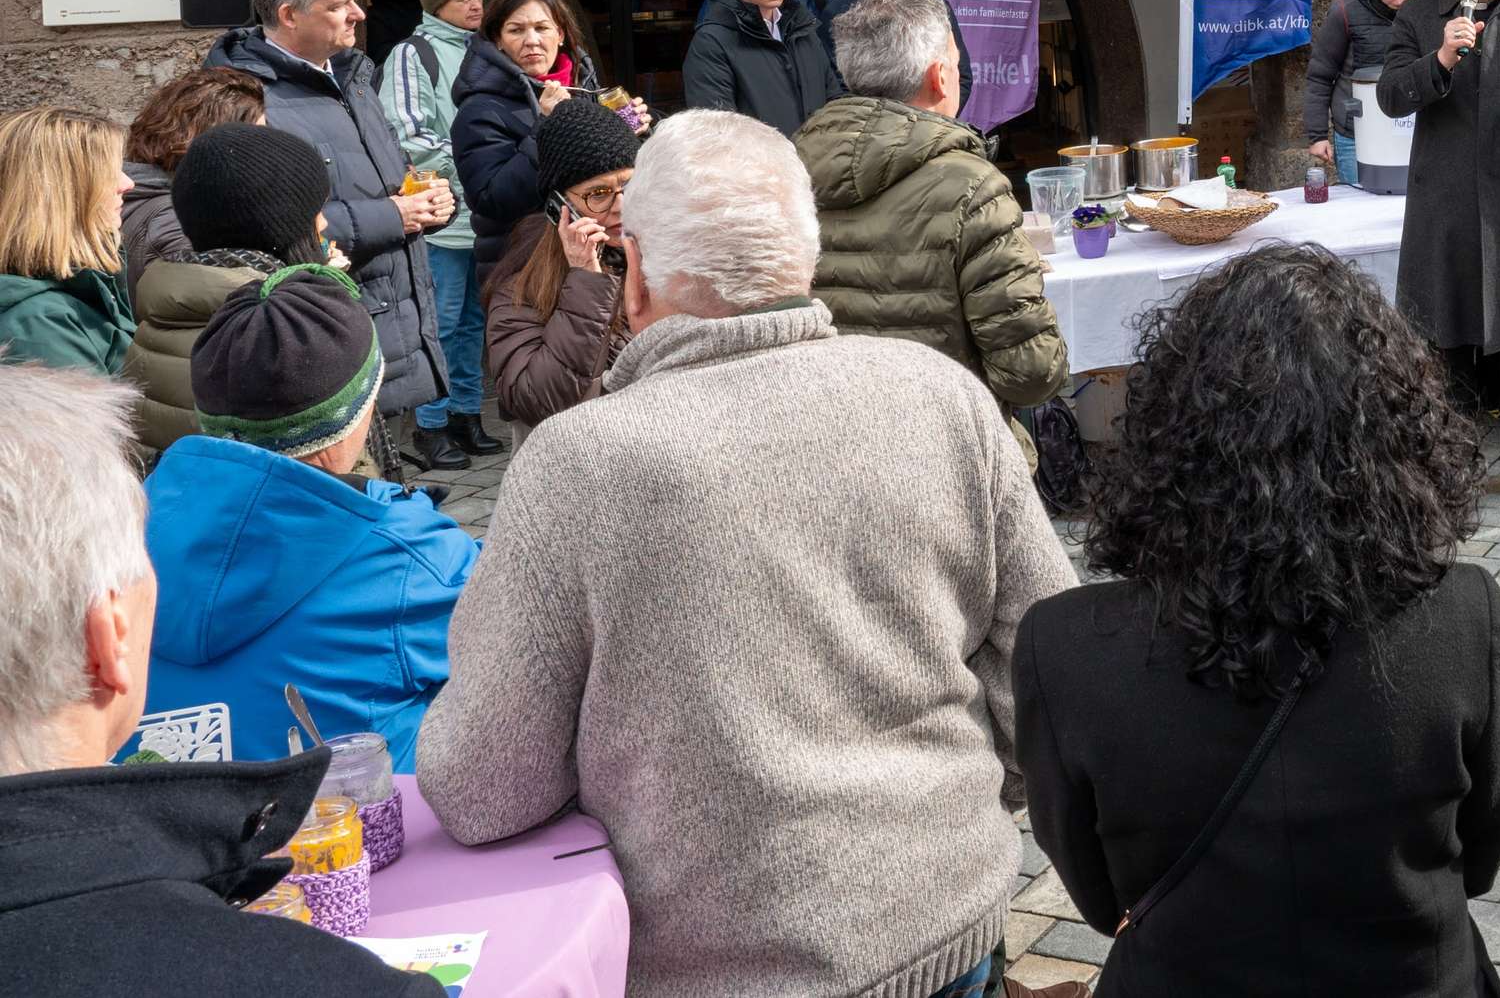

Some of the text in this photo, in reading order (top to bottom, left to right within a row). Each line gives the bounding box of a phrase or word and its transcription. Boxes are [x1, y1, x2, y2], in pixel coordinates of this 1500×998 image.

[978, 7, 1029, 19] familienfastta
[1198, 14, 1310, 34] www.dibk.at/kfb
[970, 54, 1031, 85] anke!
